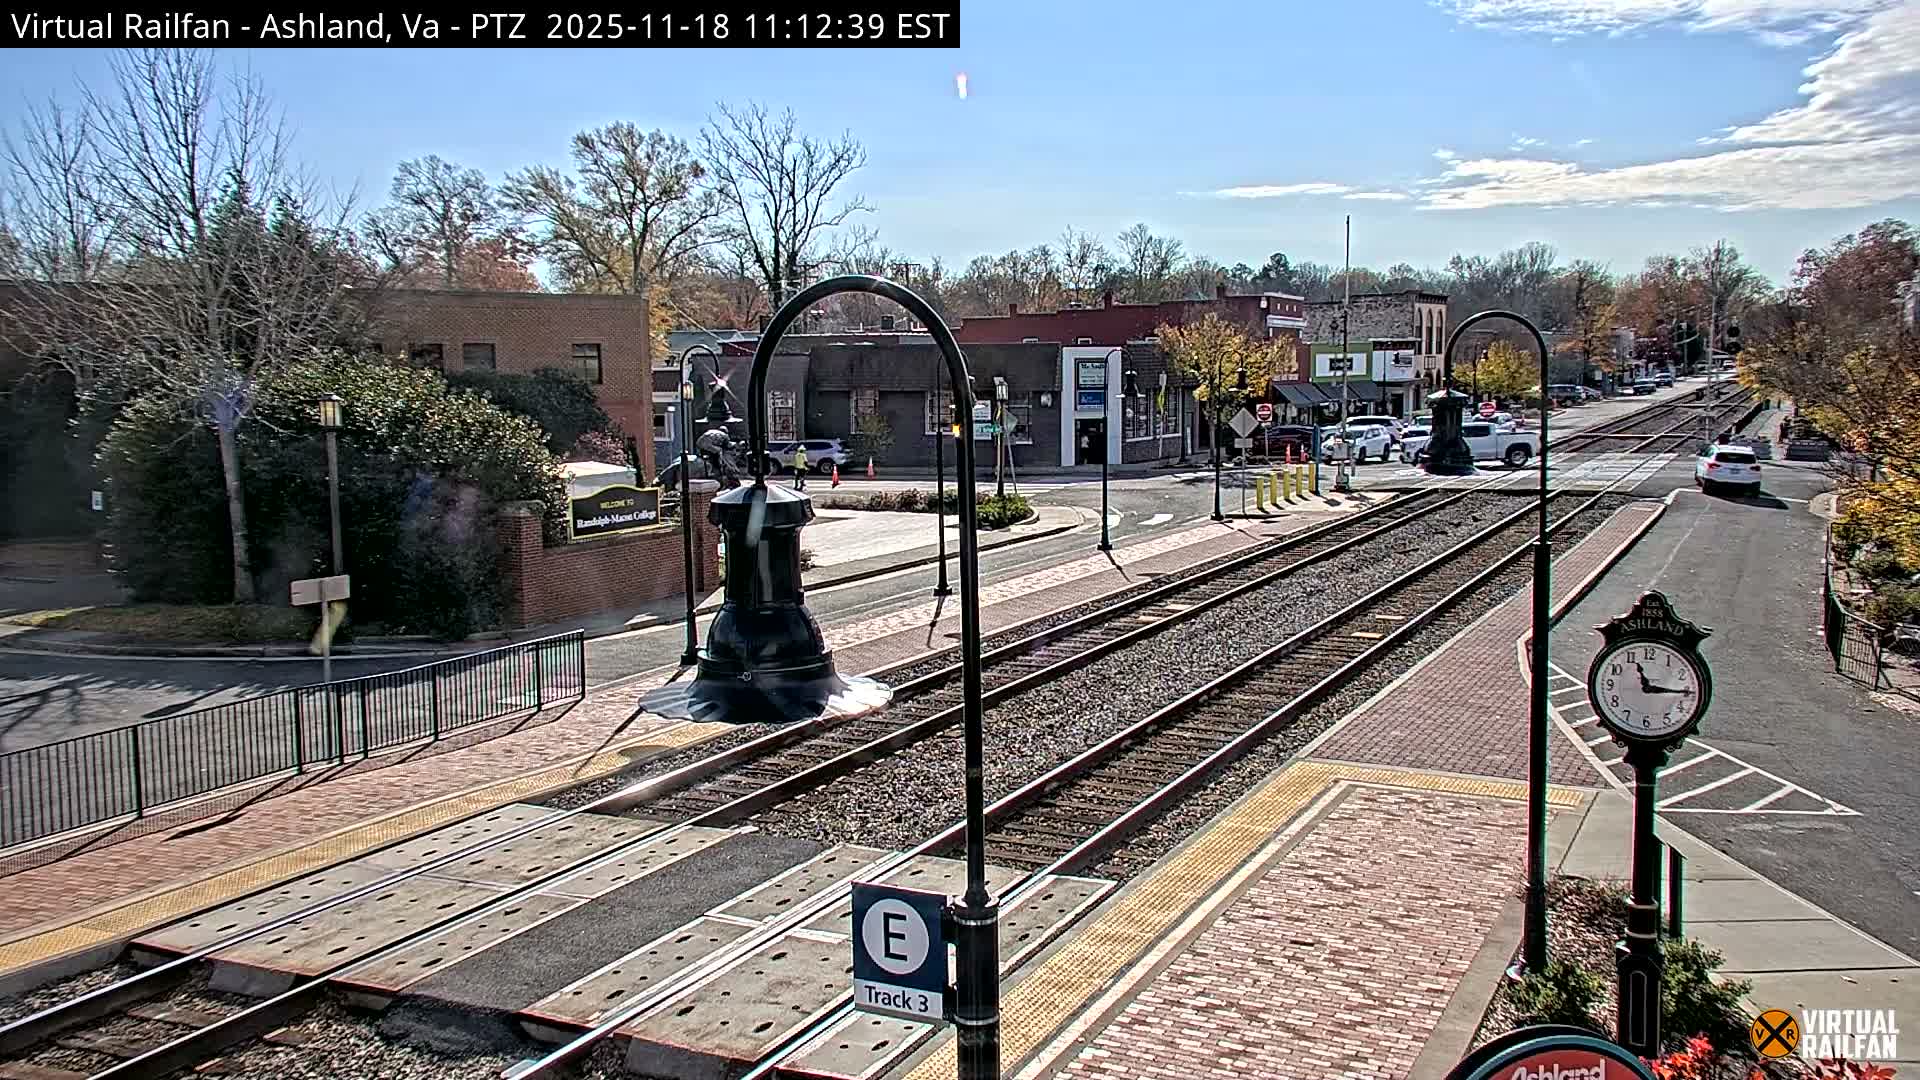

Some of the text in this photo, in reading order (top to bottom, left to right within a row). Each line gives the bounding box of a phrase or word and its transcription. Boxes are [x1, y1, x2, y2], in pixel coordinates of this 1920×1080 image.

[633, 509, 657, 521] College
[1620, 618, 1684, 636] ASHLAND
[1626, 652, 1636, 663] 11
[1643, 648, 1656, 660] 12
[1666, 655, 1671, 667] 1
[1611, 664, 1623, 676] 10
[1678, 668, 1686, 681] 2
[1606, 679, 1615, 691] 9
[1610, 695, 1620, 708] 8
[1677, 700, 1687, 713] 4
[1622, 710, 1631, 721] 7
[1642, 715, 1651, 728] 6
[1662, 713, 1671, 726] 5
[883, 911, 908, 961] E
[864, 985, 929, 1013] Track 3
